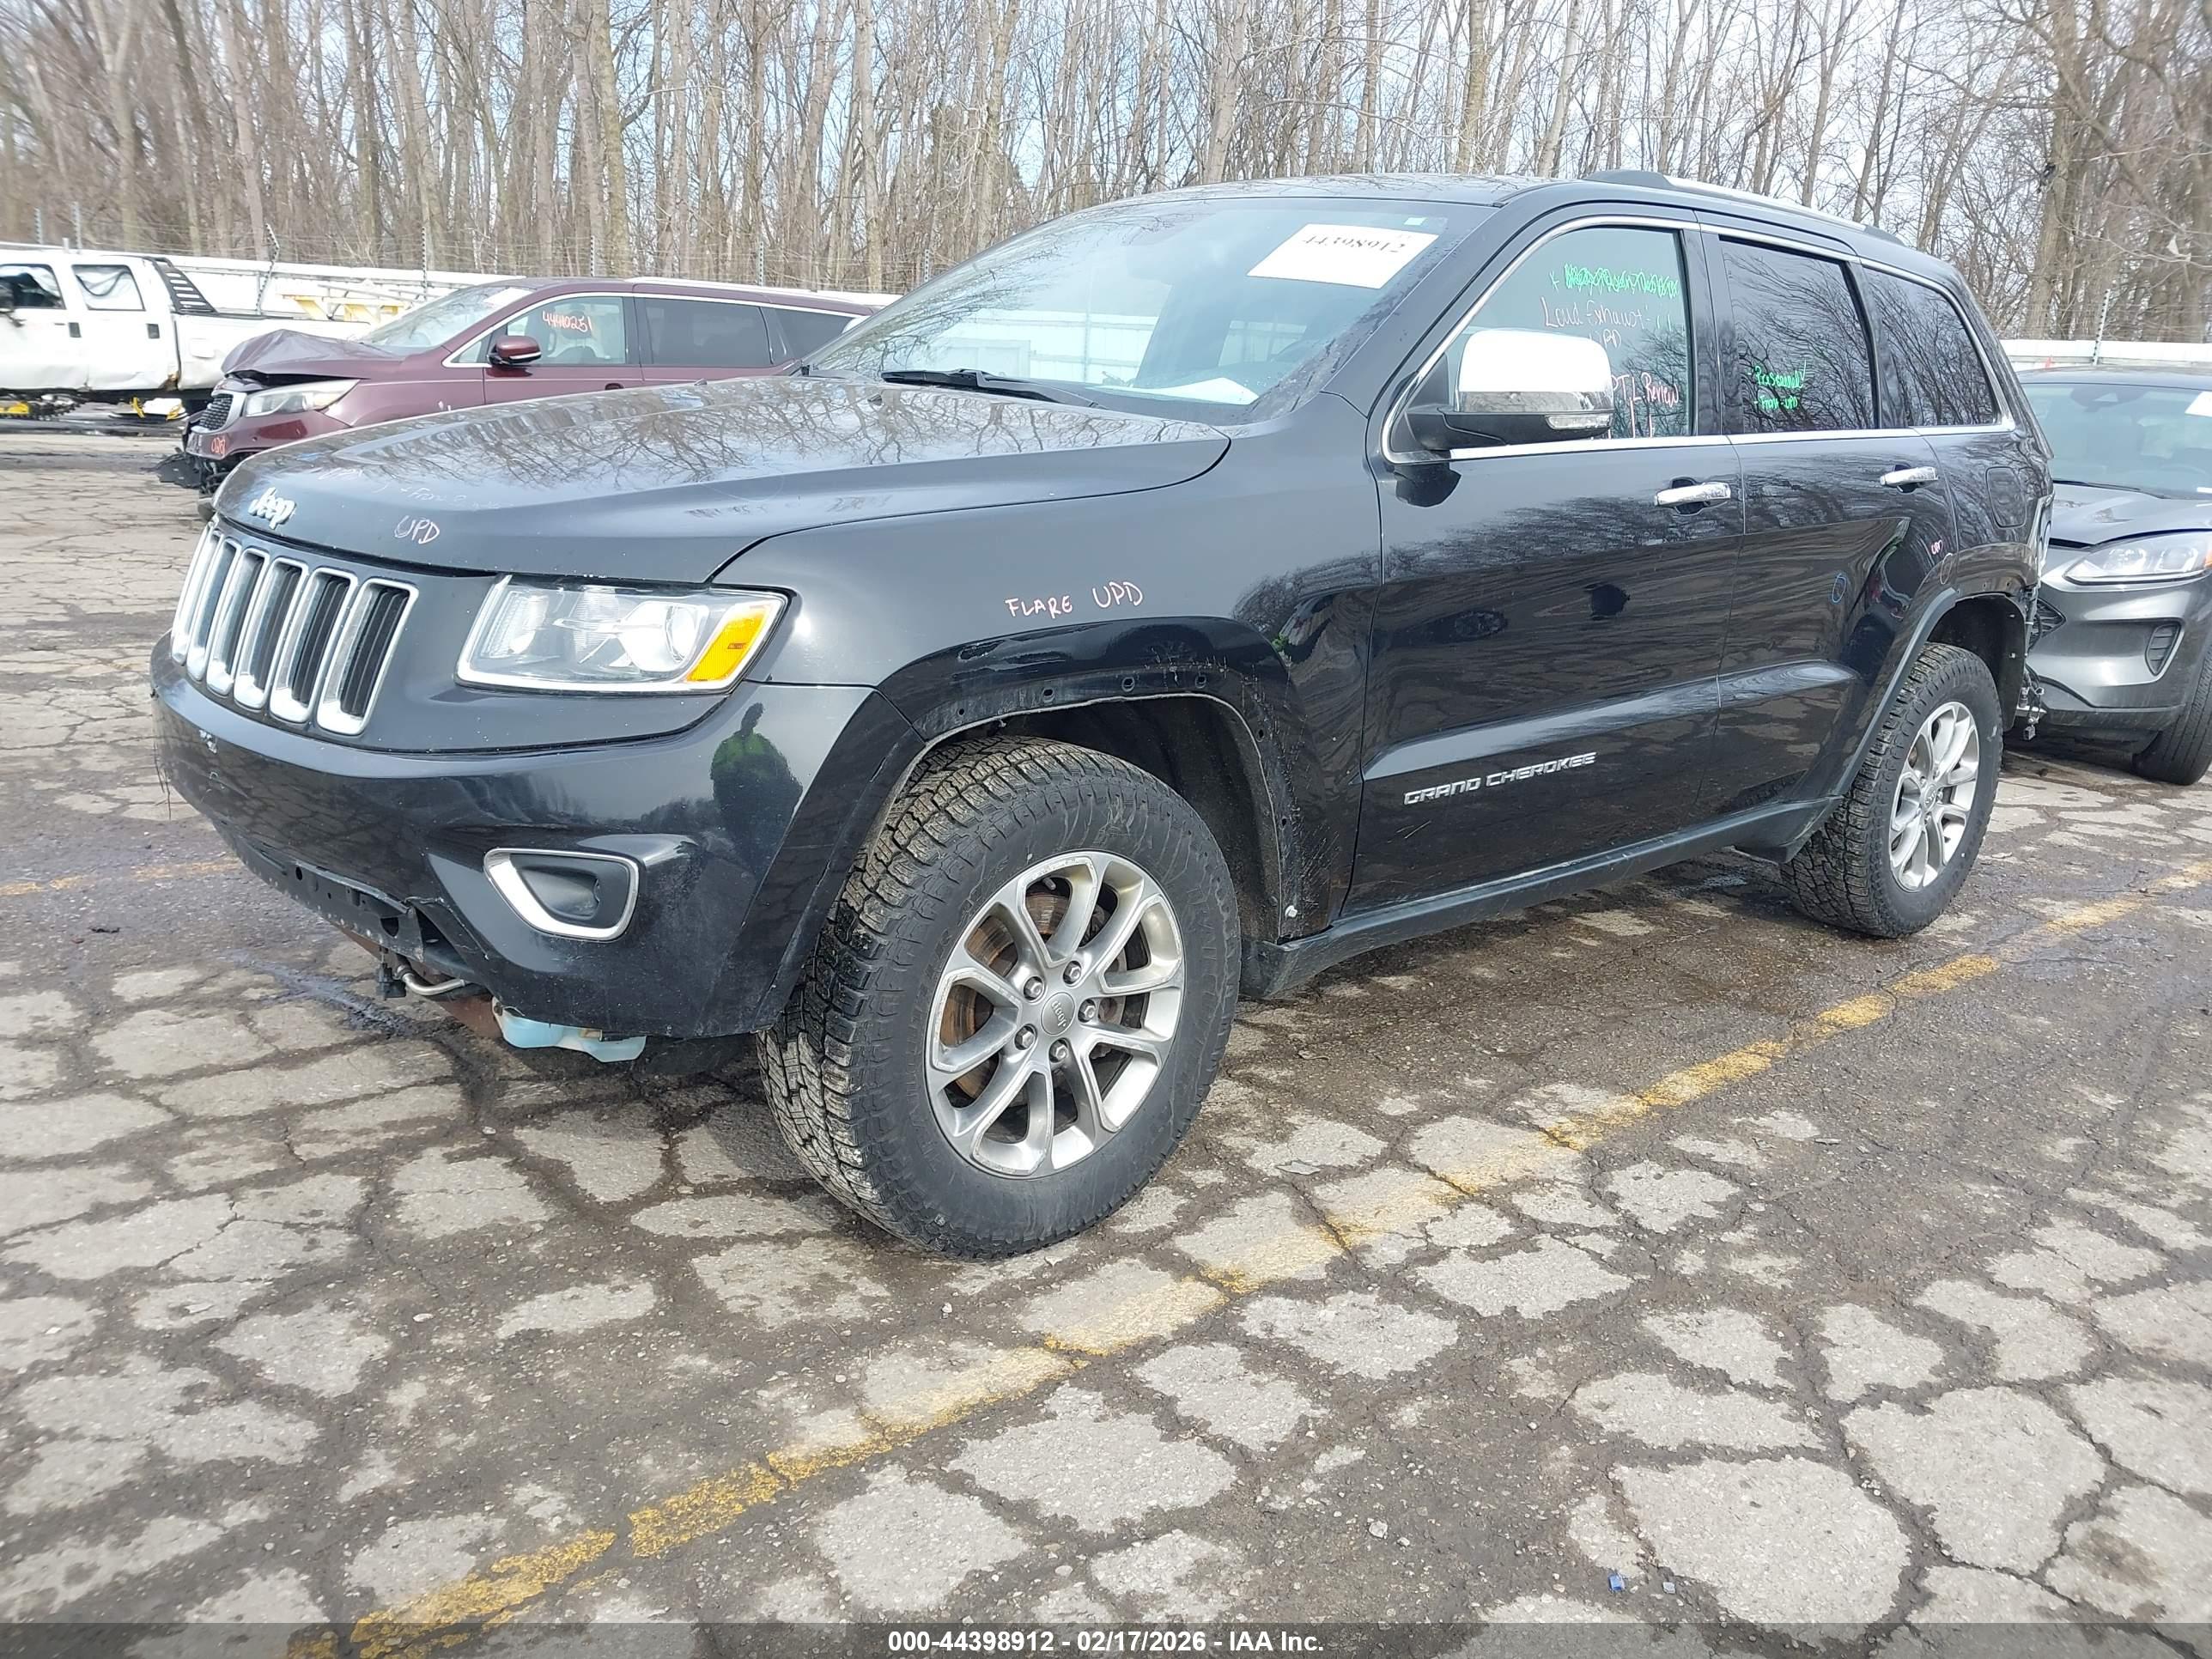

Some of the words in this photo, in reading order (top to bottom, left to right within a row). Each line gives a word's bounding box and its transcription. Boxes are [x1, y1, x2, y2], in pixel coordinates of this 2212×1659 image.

[542, 310, 592, 332] 44410251
[248, 486, 296, 530] Jeep
[393, 515, 441, 544] UPD
[1005, 595, 1073, 619] FLARE
[1092, 581, 1144, 608] UPD
[1404, 777, 1481, 805] GRAND
[1486, 751, 1597, 787] CHEROKEE
